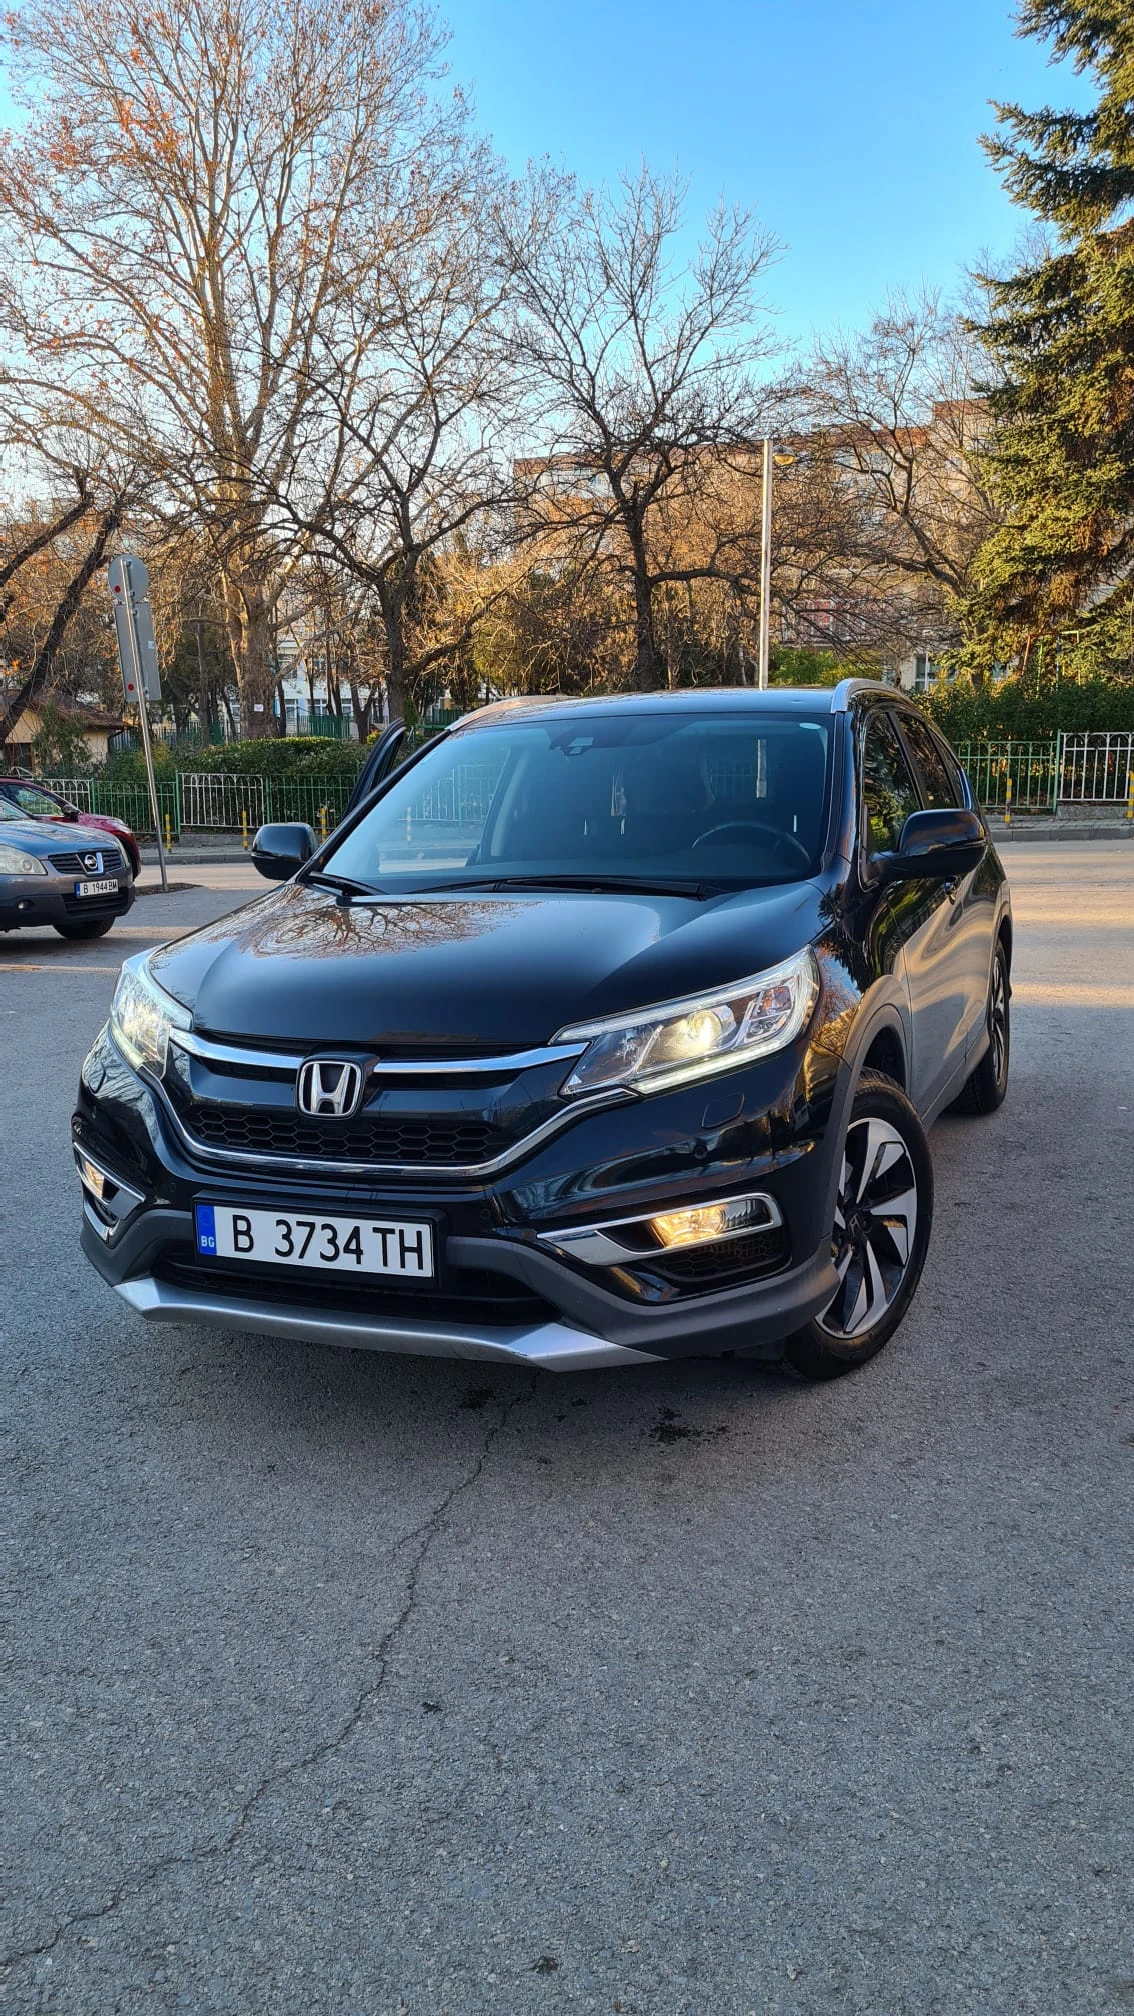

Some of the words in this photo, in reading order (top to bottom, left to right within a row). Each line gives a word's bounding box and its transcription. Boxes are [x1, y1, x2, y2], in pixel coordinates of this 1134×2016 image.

[201, 1235, 215, 1248] BG
[232, 1214, 254, 1253] B
[274, 1219, 363, 1265] 3734
[372, 1226, 424, 1270] TH
